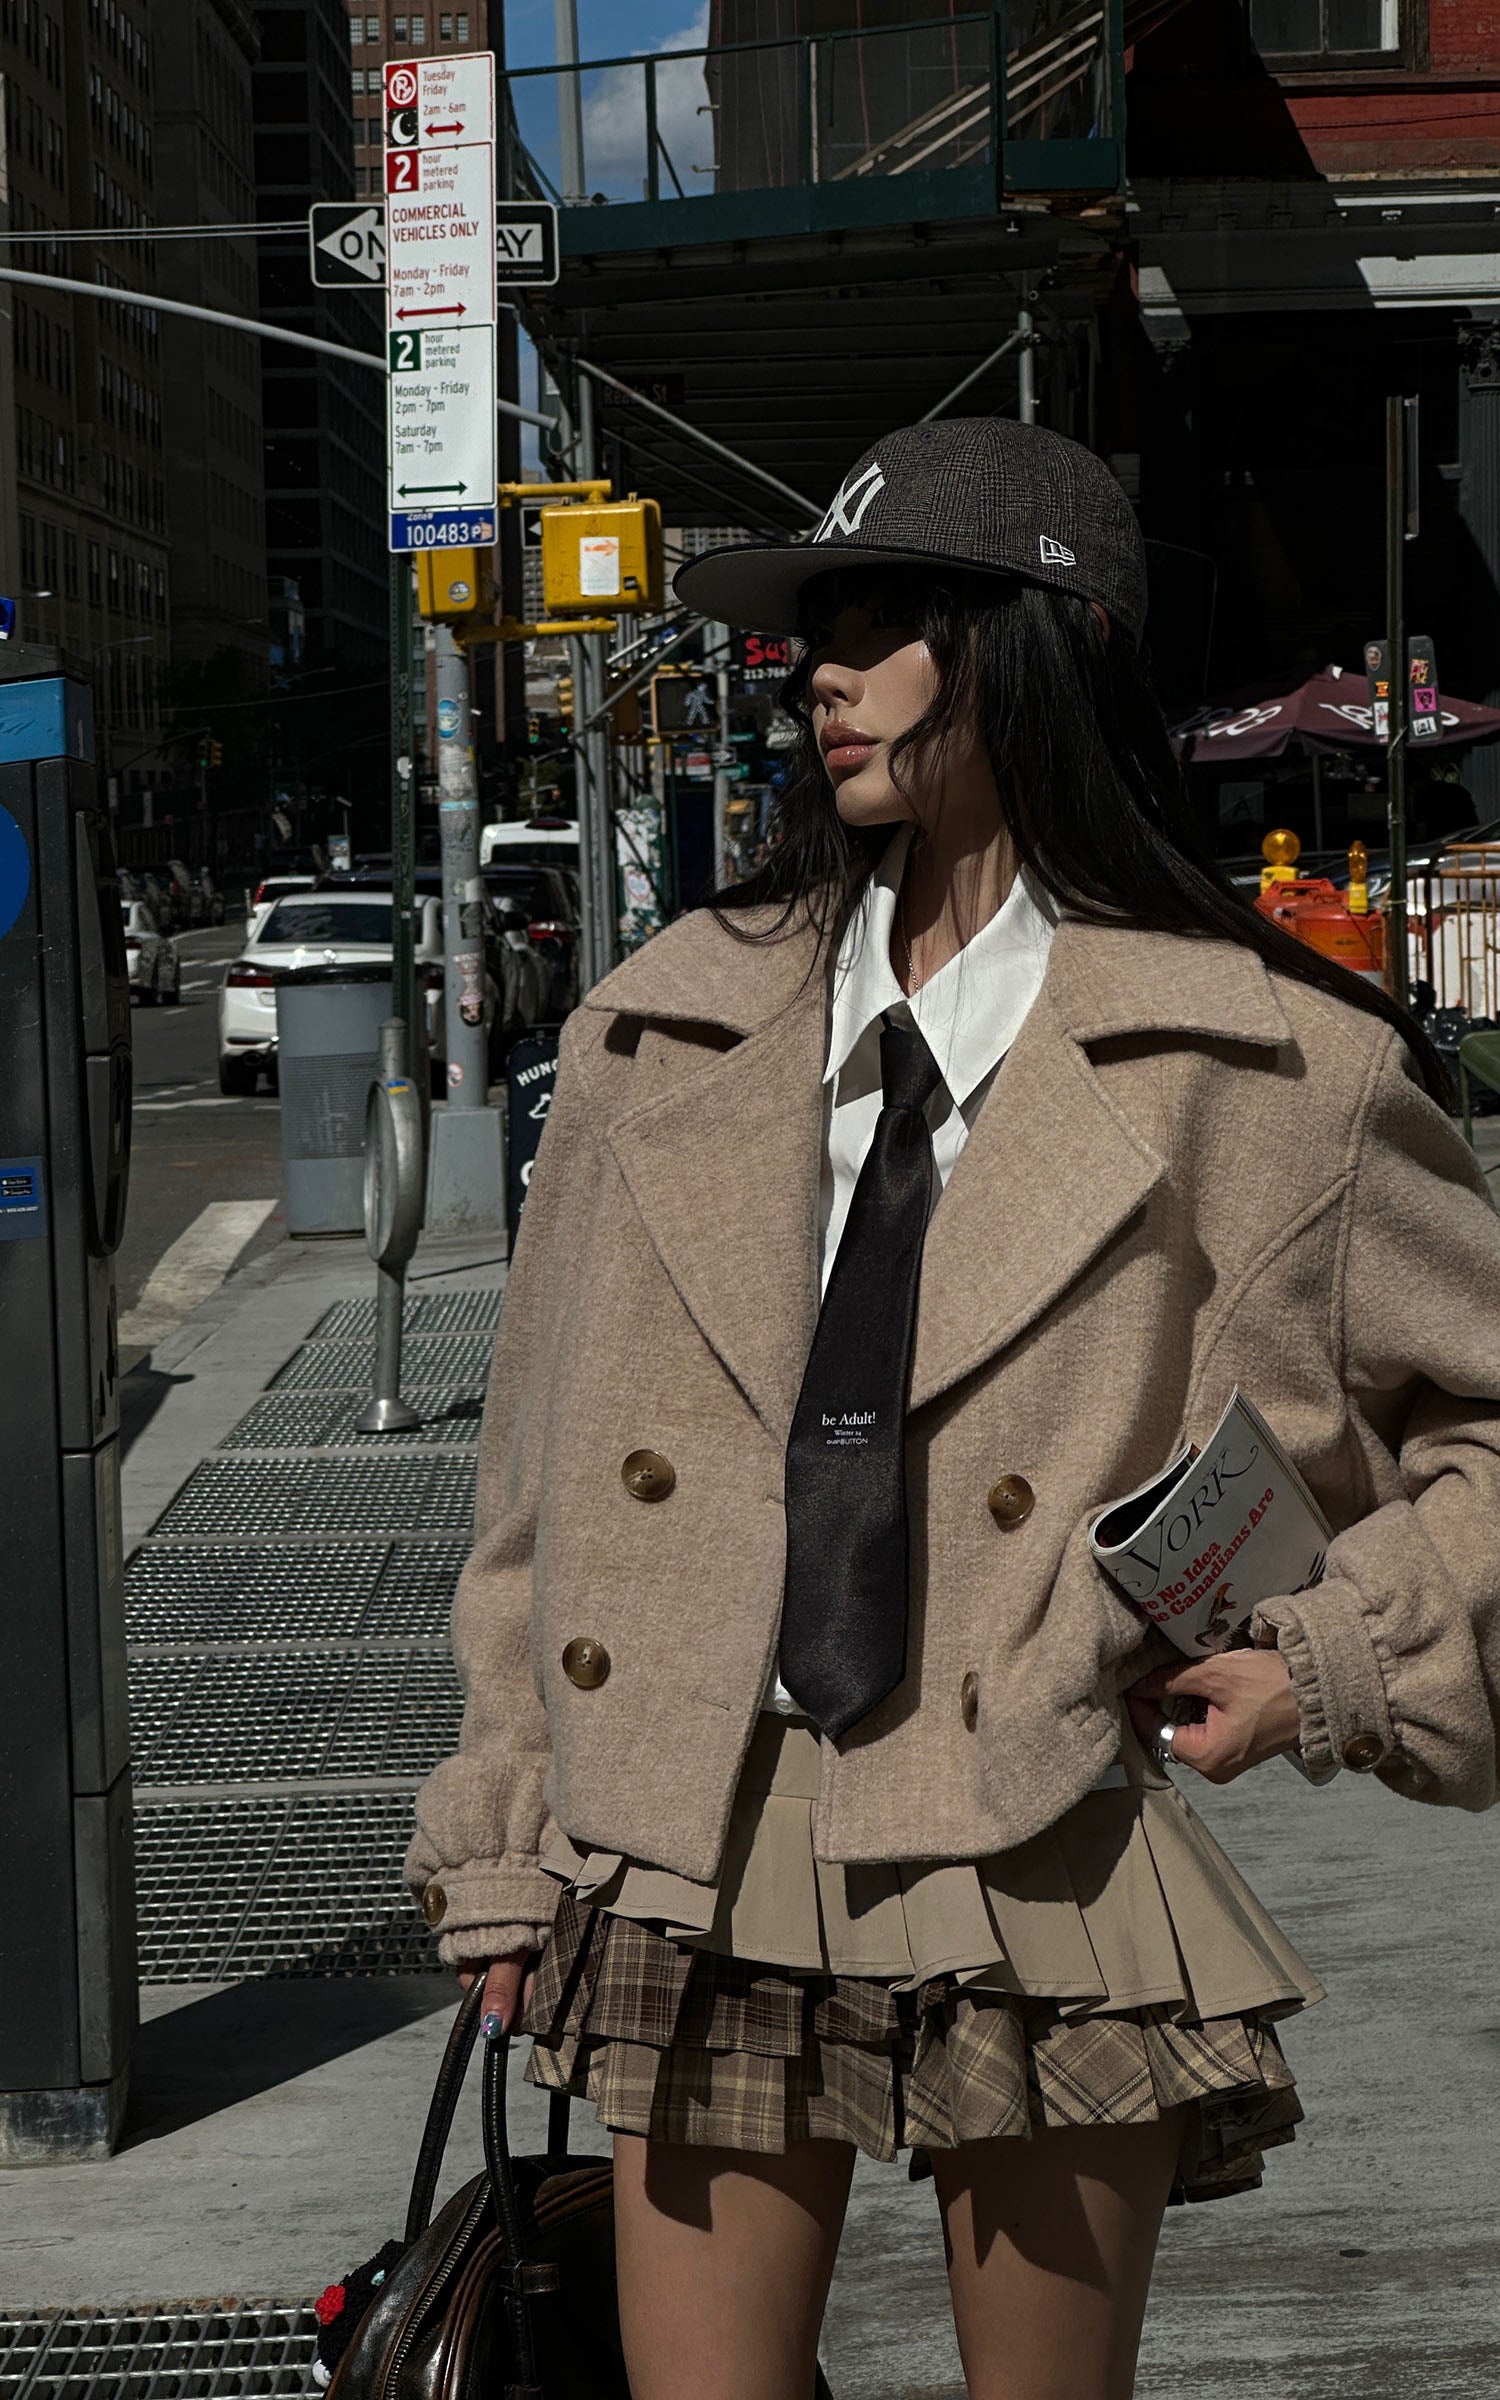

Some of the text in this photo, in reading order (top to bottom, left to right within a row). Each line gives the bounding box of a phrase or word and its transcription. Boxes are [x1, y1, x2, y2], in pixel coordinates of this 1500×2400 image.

[423, 70, 456, 82] Tuesday
[423, 84, 447, 96] Friday
[423, 105, 440, 116] 2am
[448, 103, 466, 113] 6am
[423, 152, 442, 164] hour
[394, 154, 412, 191] 2
[423, 164, 458, 177] metered
[423, 179, 455, 193] parking
[392, 202, 466, 223] COMMERCIAL
[393, 221, 480, 243] VEHICLES ONLY
[340, 230, 386, 260] ON
[497, 229, 534, 258] AY
[393, 266, 430, 282] Monday
[440, 263, 470, 279] Friday
[393, 284, 414, 297] 7am
[423, 282, 446, 297] 2pm
[425, 333, 444, 344] hour
[396, 334, 414, 370] 2
[425, 343, 461, 356] metered
[425, 356, 456, 369] parking
[395, 383, 431, 398] Monday
[440, 381, 470, 396] Friday
[395, 401, 417, 416] 2pm
[425, 400, 446, 414] 7pm
[395, 424, 437, 439] Saturday
[395, 442, 415, 455] 7am
[424, 439, 443, 453] 7pm
[406, 522, 470, 547] 100483
[821, 1410, 877, 1426] be Adult!
[1121, 1444, 1259, 1598] YORK
[1169, 1524, 1252, 1617] Canadians
[1247, 1487, 1275, 1529] Are
[1157, 1580, 1187, 1611] No
[1182, 1540, 1222, 1584] Idea
